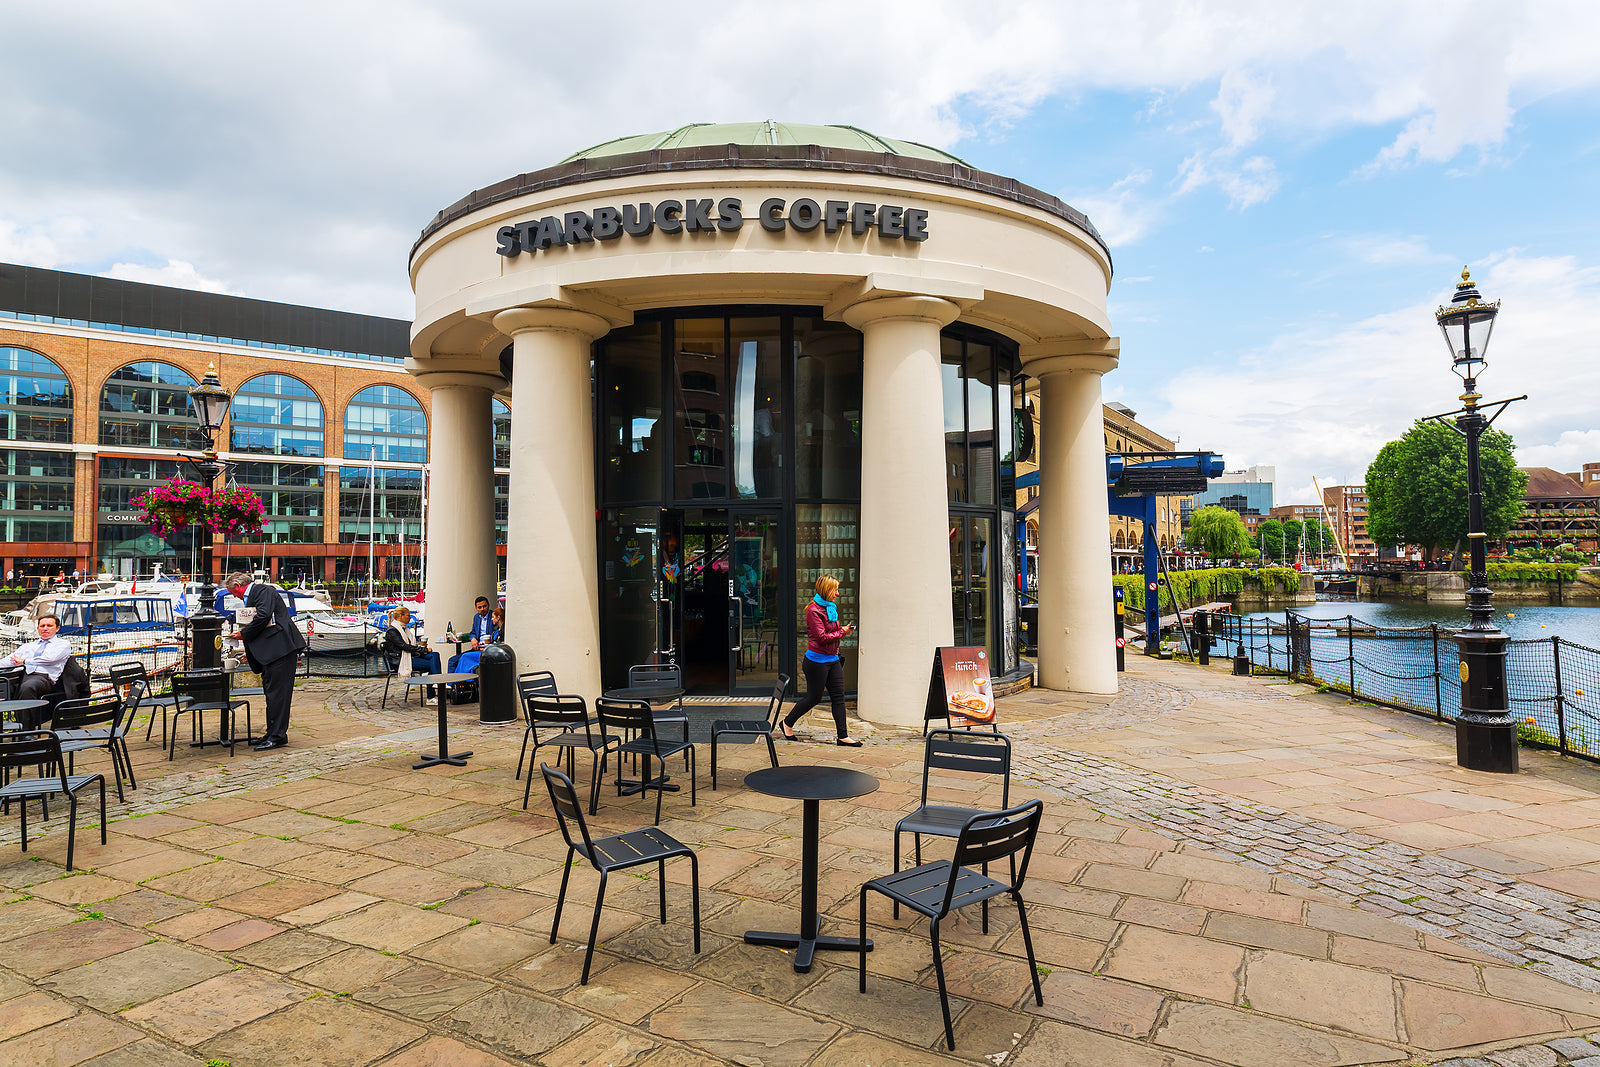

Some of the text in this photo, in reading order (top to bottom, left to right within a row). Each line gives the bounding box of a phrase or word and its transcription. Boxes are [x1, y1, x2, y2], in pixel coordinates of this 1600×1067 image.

[496, 197, 929, 258] STARBUCKS COFFEE
[955, 661, 978, 671] lunch
